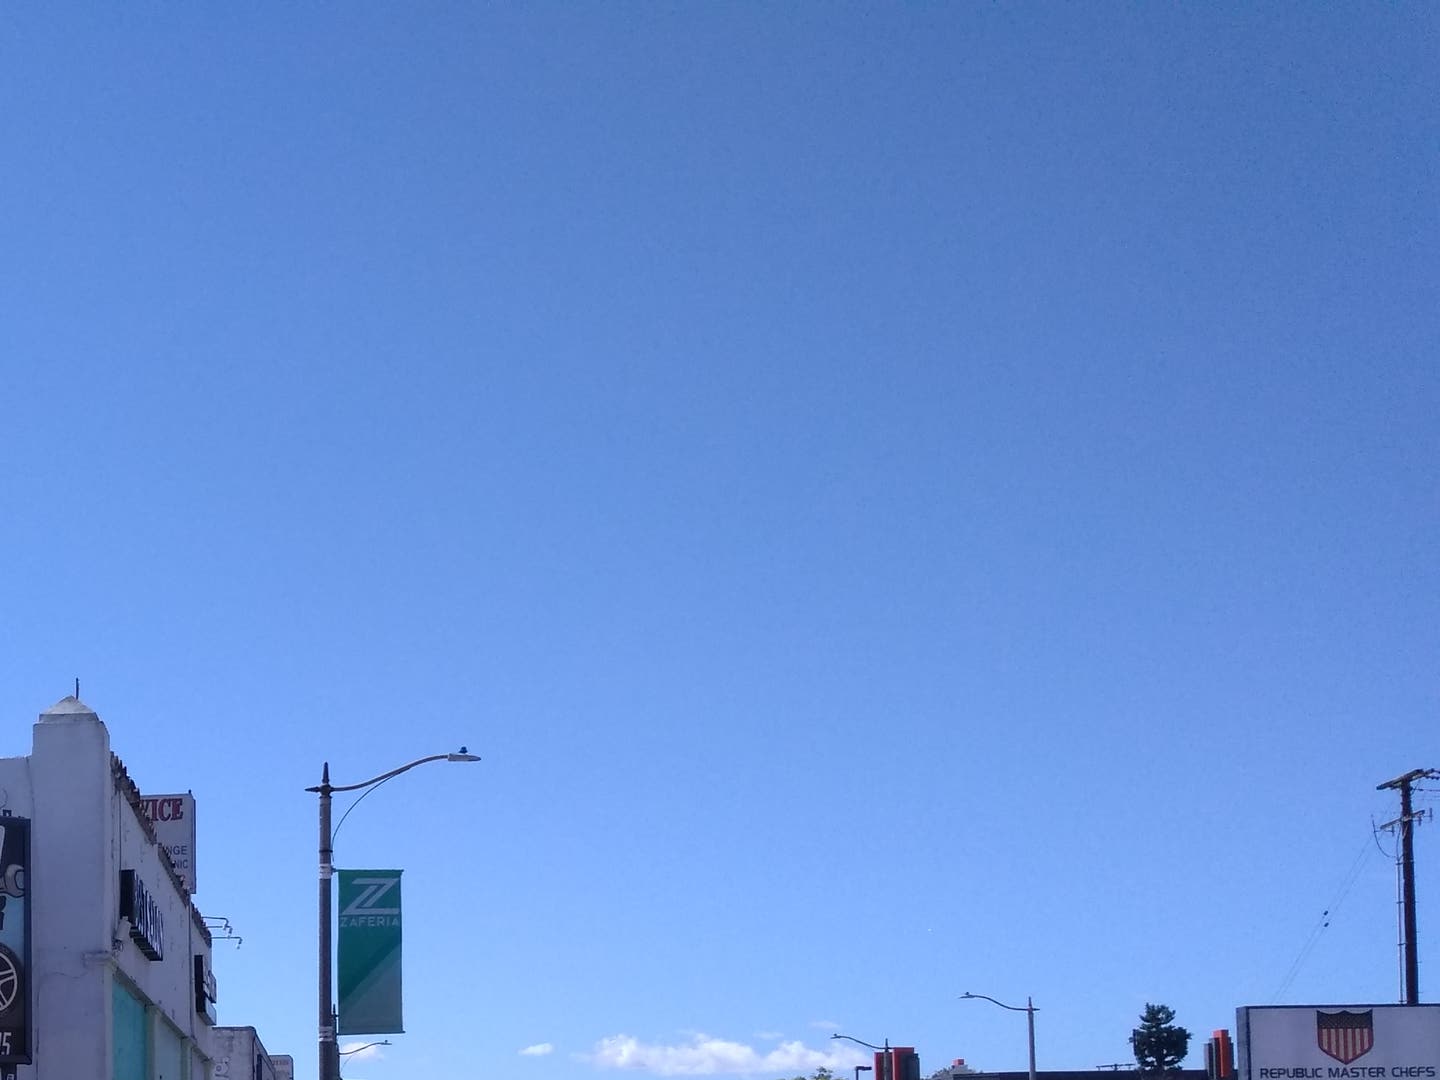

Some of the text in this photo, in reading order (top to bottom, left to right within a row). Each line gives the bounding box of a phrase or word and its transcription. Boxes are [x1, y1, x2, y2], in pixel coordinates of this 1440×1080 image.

[339, 916, 400, 928] ZAFERIA
[1259, 1066, 1436, 1079] REPUBLIC MASTER CHEFS
